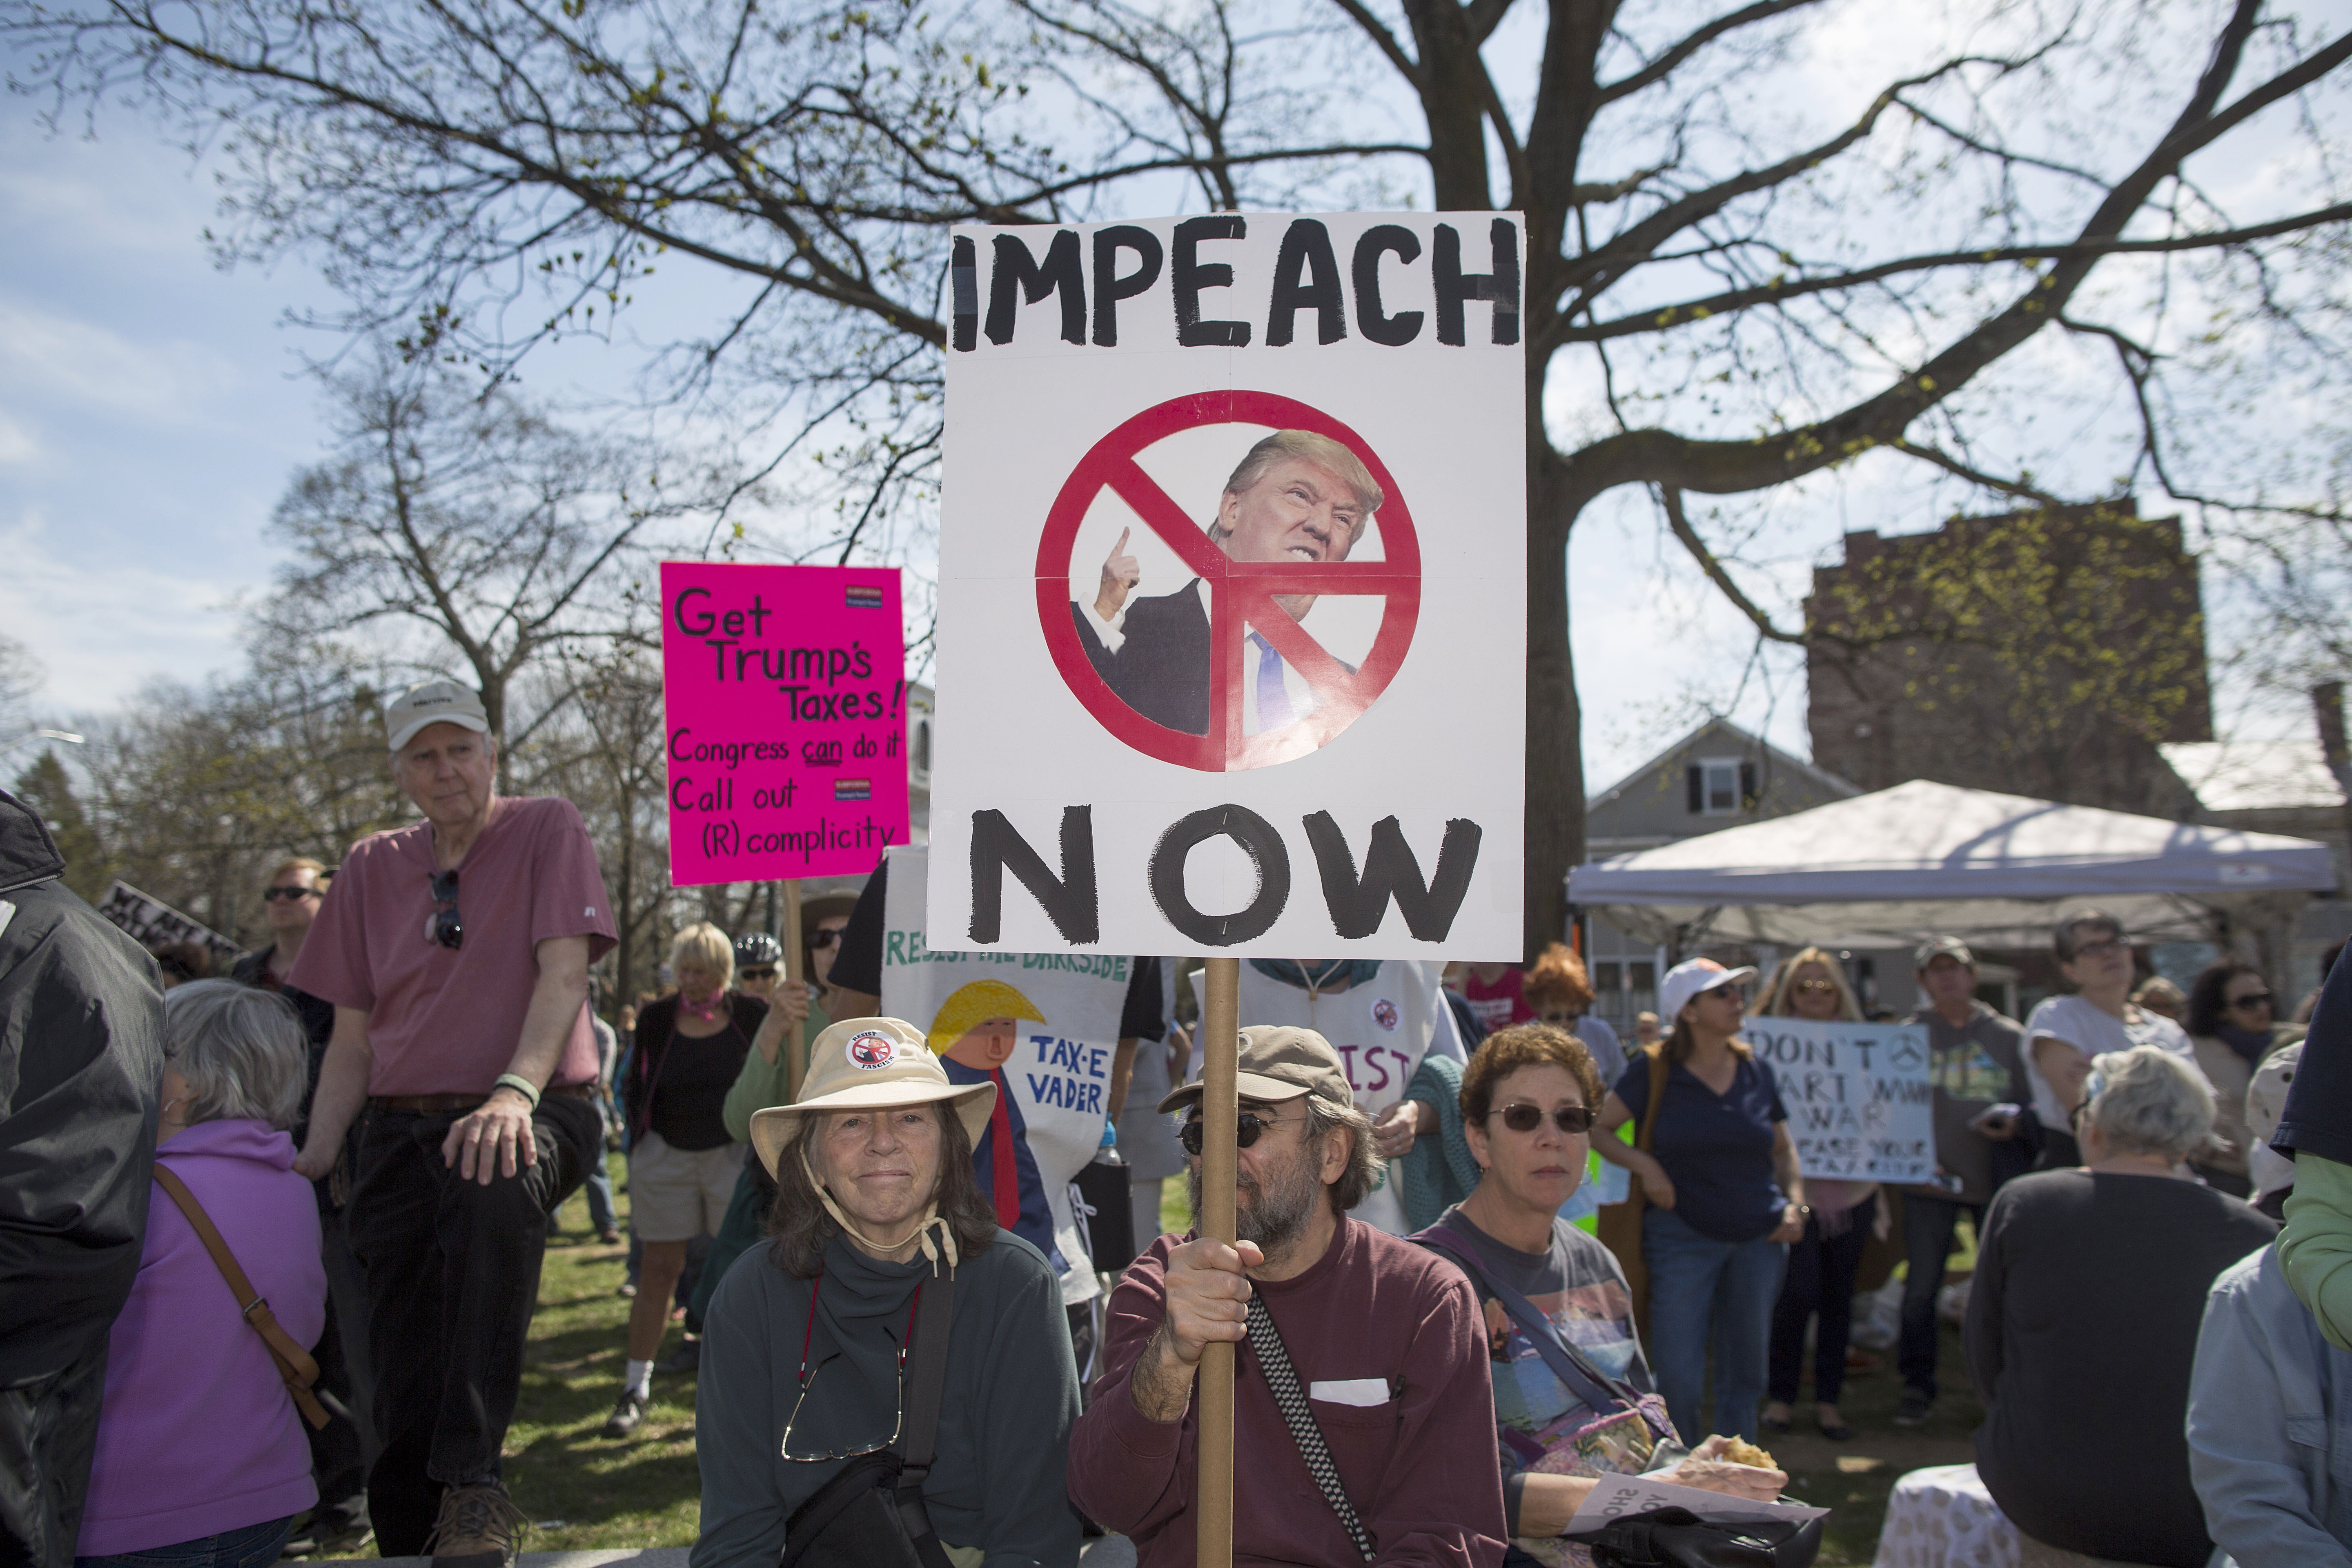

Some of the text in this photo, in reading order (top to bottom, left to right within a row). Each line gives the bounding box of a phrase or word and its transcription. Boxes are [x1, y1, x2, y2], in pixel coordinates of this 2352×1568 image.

[952, 216, 1520, 352] IMPEACH
[674, 587, 772, 637] Get
[705, 640, 872, 687] Trump's
[779, 679, 903, 722] Taxes!
[670, 728, 901, 770] Congress can do it
[672, 777, 797, 811] Call out
[703, 815, 895, 864] (R) complicity
[968, 804, 1482, 947] NOW
[852, 1031, 877, 1042] RESIST
[861, 1056, 895, 1069] FASCISM
[1339, 1045, 1410, 1091] IST
[1027, 1073, 1102, 1115] VADER
[1776, 1071, 1847, 1103] ART
